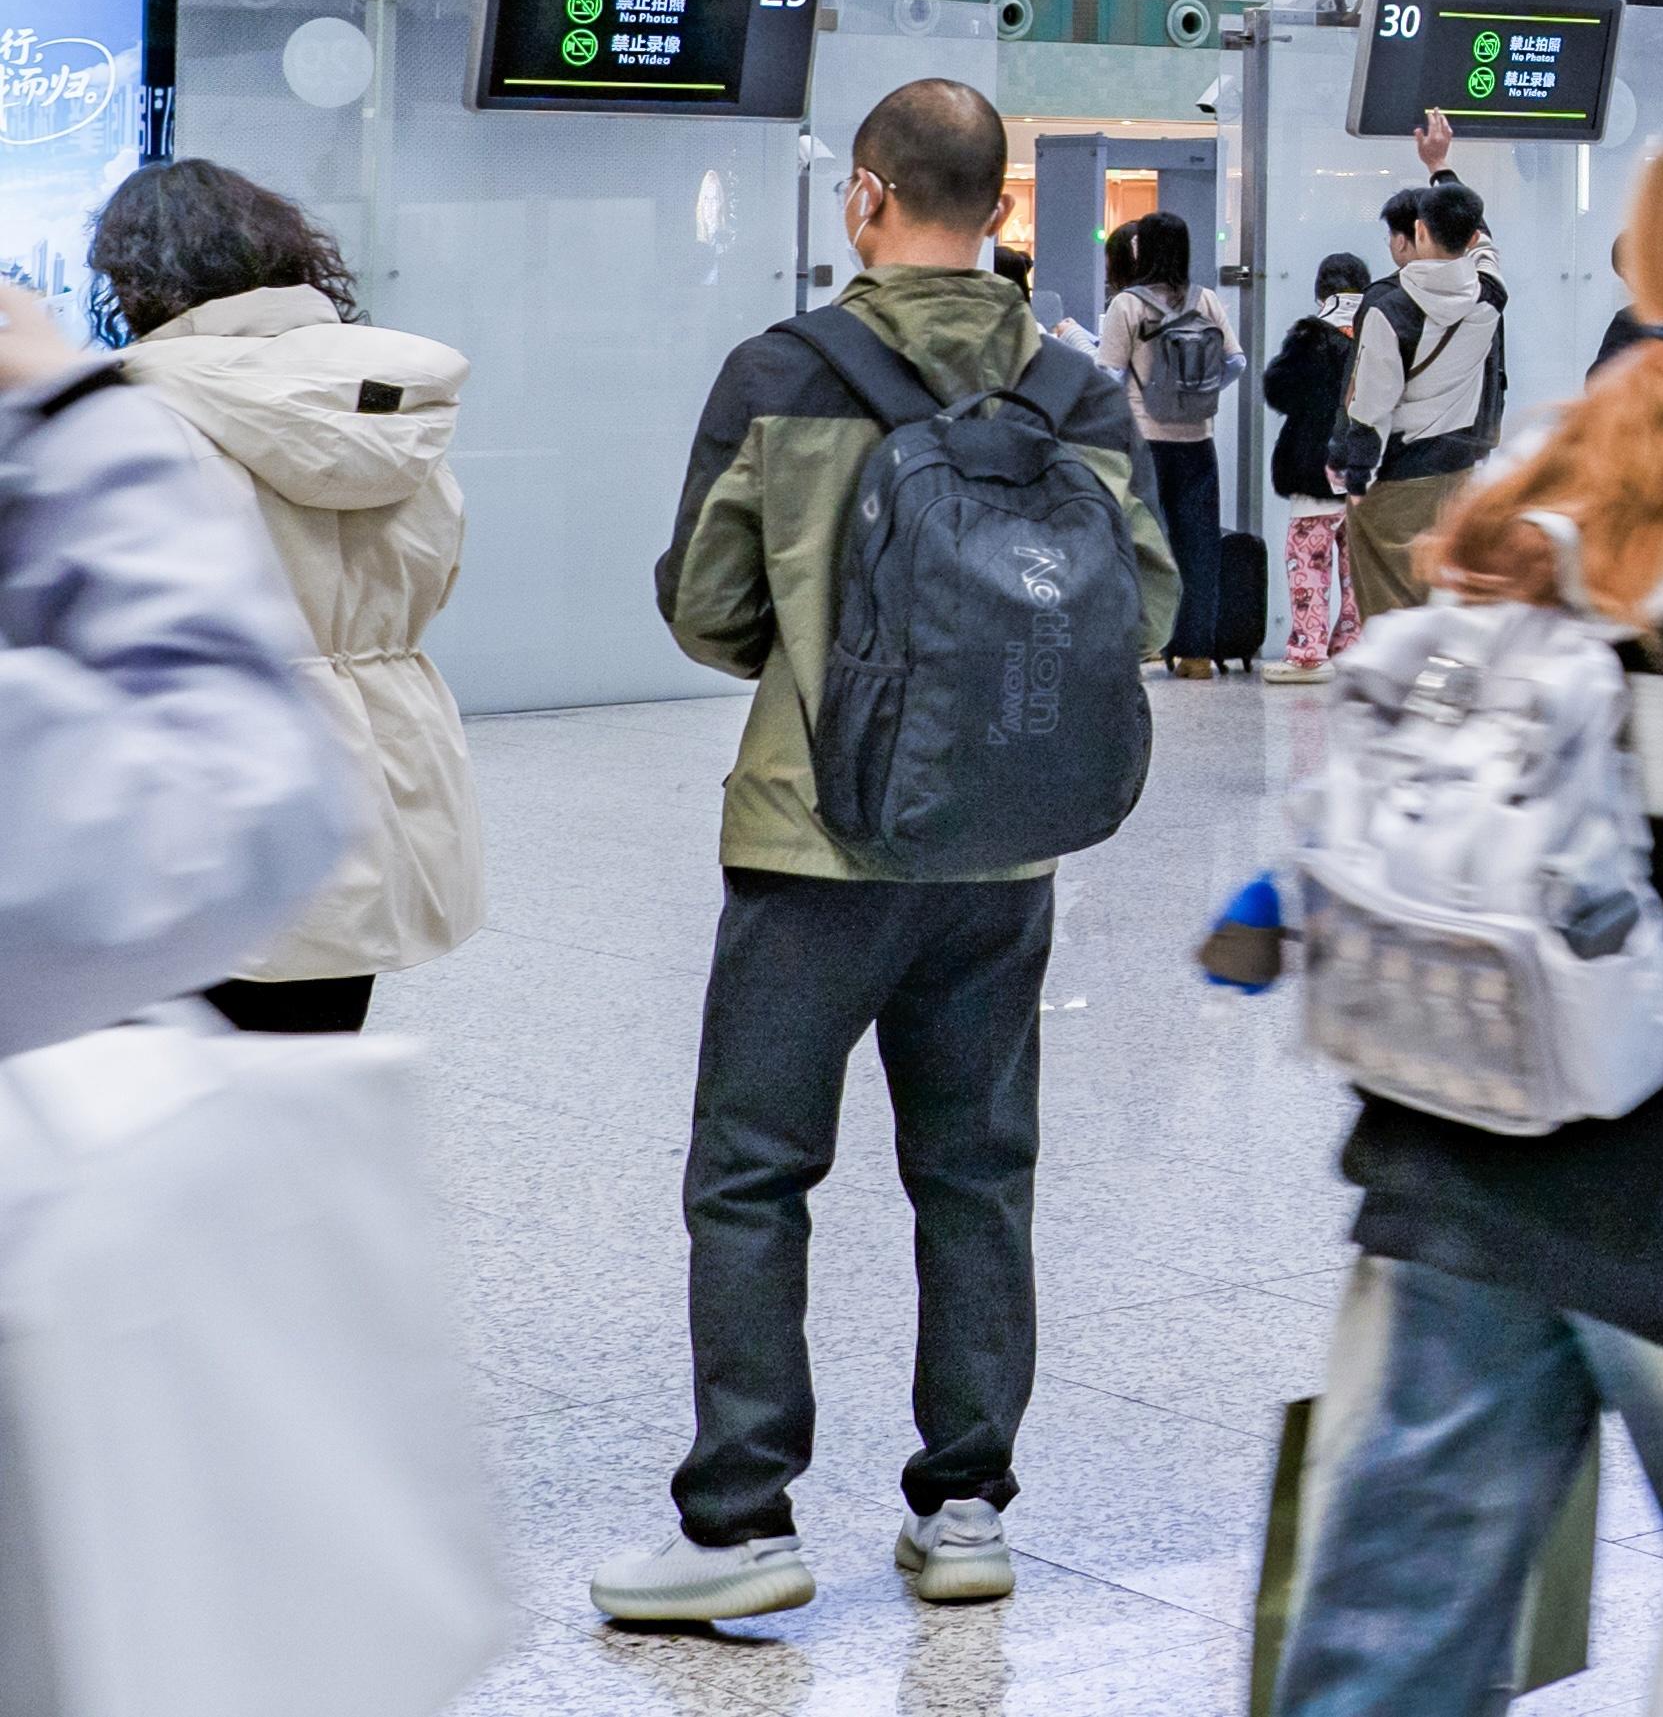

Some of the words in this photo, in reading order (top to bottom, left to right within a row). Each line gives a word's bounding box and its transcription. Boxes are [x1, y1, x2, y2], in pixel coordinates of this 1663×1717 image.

[619, 12, 636, 23] No
[639, 12, 679, 25] Photos
[1379, 4, 1421, 38] 30
[610, 34, 681, 54] 禁止录像
[1509, 35, 1562, 53] 禁止拍照
[618, 54, 636, 64] No
[638, 55, 671, 65] Video
[1511, 52, 1524, 62] No
[1526, 53, 1555, 63] Photos
[1503, 71, 1556, 88] 禁止录像
[1508, 87, 1522, 97] No
[1523, 88, 1548, 98] Video
